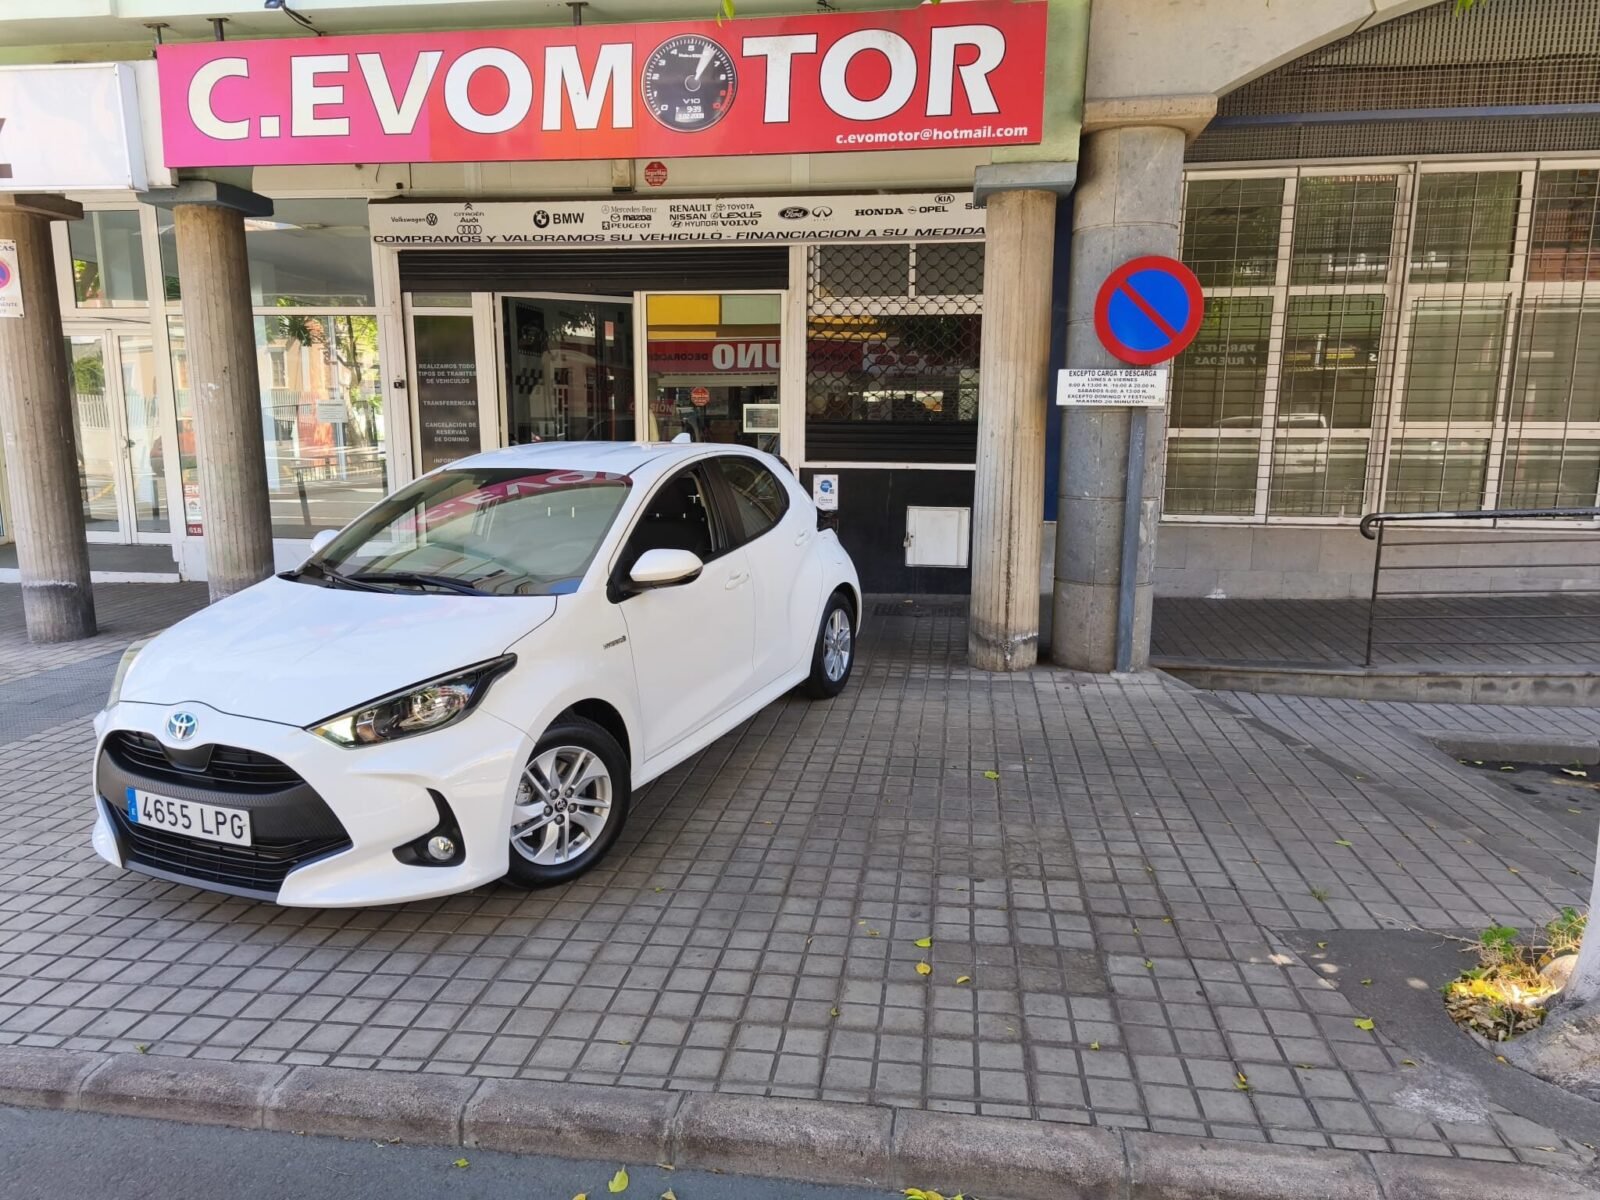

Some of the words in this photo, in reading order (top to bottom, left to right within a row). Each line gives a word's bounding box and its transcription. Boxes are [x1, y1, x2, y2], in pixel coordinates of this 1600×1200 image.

[836, 126, 1028, 144] c.evomotor@hotmail.com
[670, 204, 712, 212] RENAULT
[854, 208, 904, 216] HONDA
[553, 213, 584, 224] BMW
[639, 232, 722, 241] VEHICULO
[736, 230, 861, 239] FINANCIACION
[914, 227, 985, 236] MEDIDA
[143, 796, 192, 829] 4655
[200, 808, 244, 839] LPG
